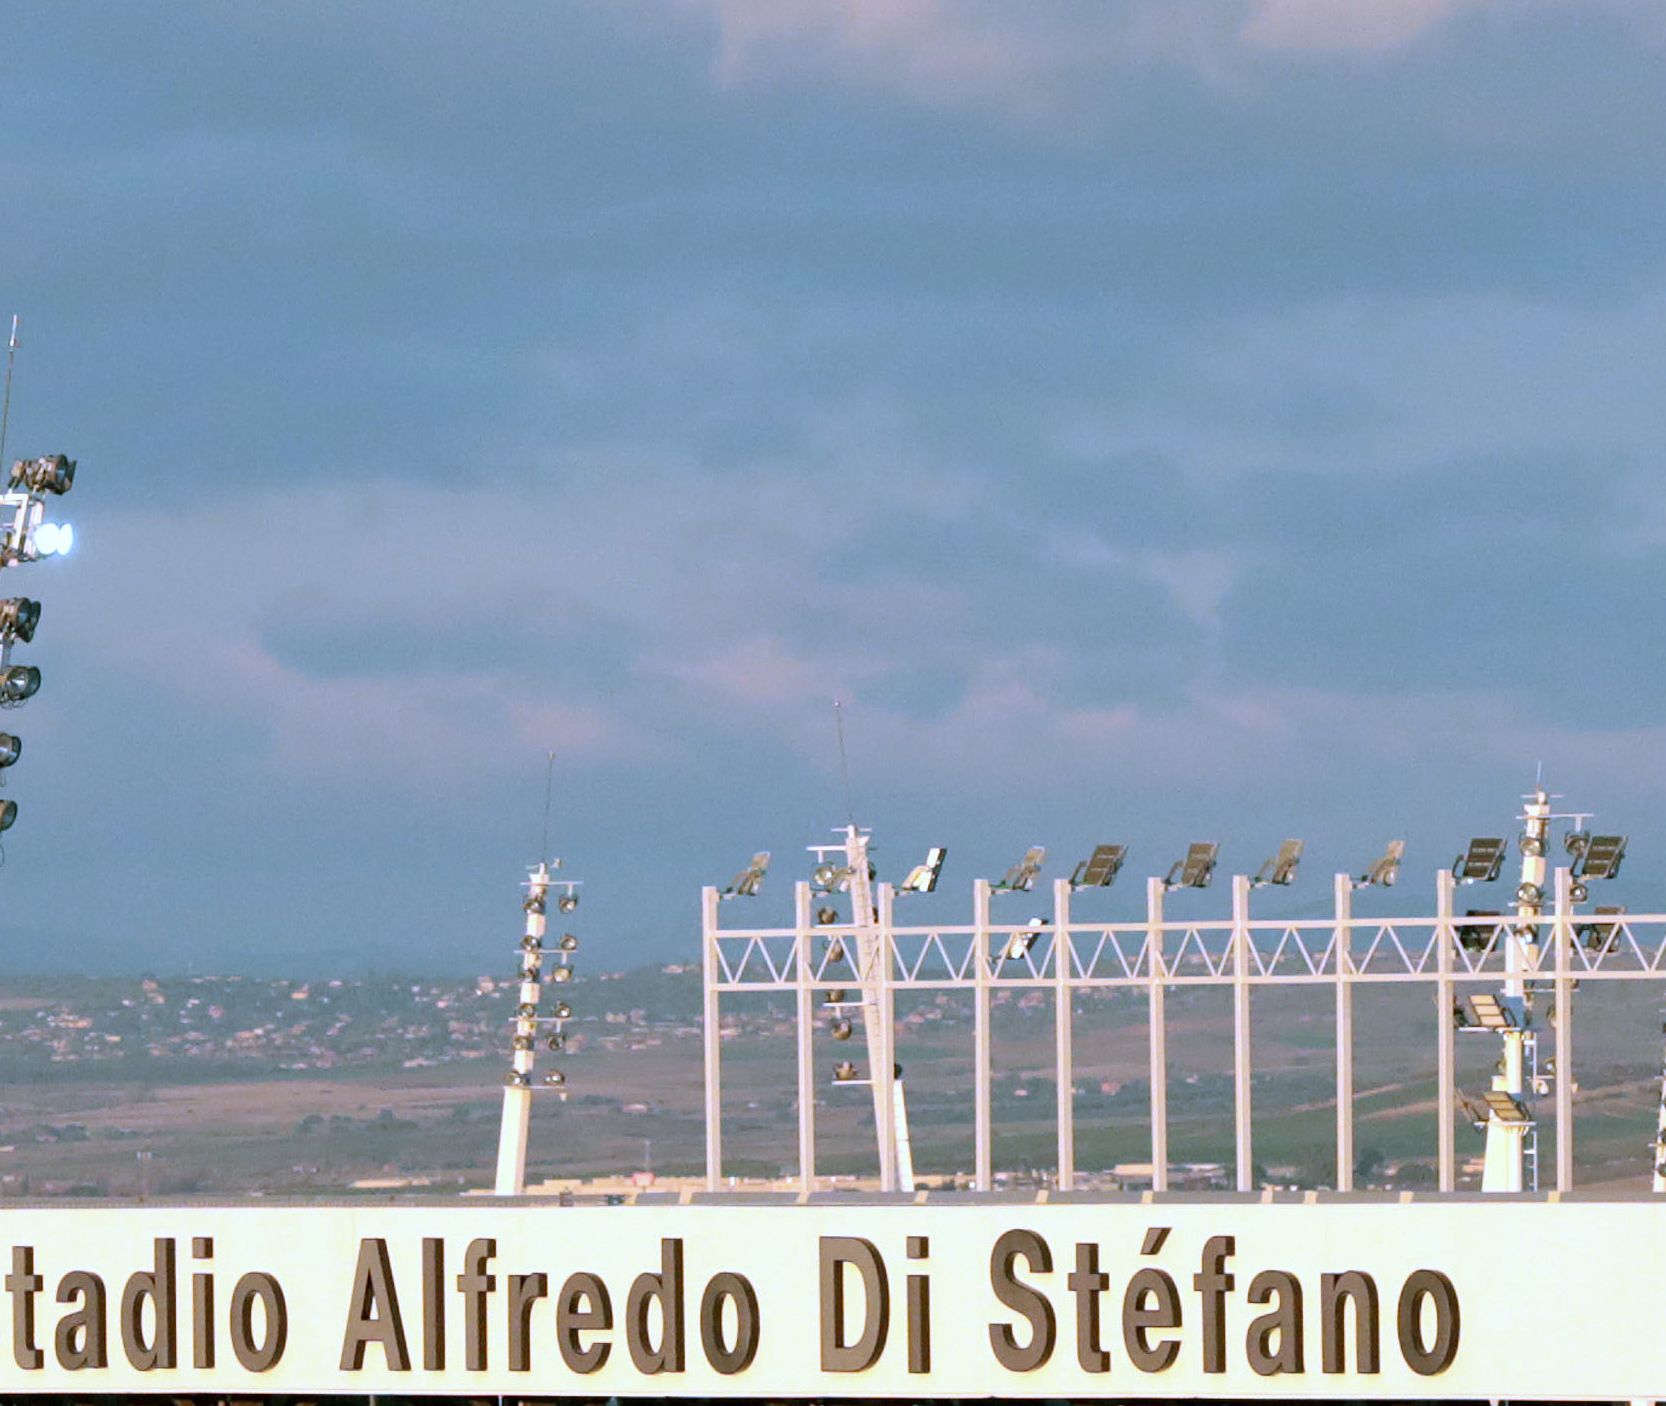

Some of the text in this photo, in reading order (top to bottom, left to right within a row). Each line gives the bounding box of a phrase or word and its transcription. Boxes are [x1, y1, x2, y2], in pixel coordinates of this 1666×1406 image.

[339, 1236, 761, 1375] Alfredo
[818, 1235, 931, 1374] Di
[987, 1226, 1461, 1377] Stéfano
